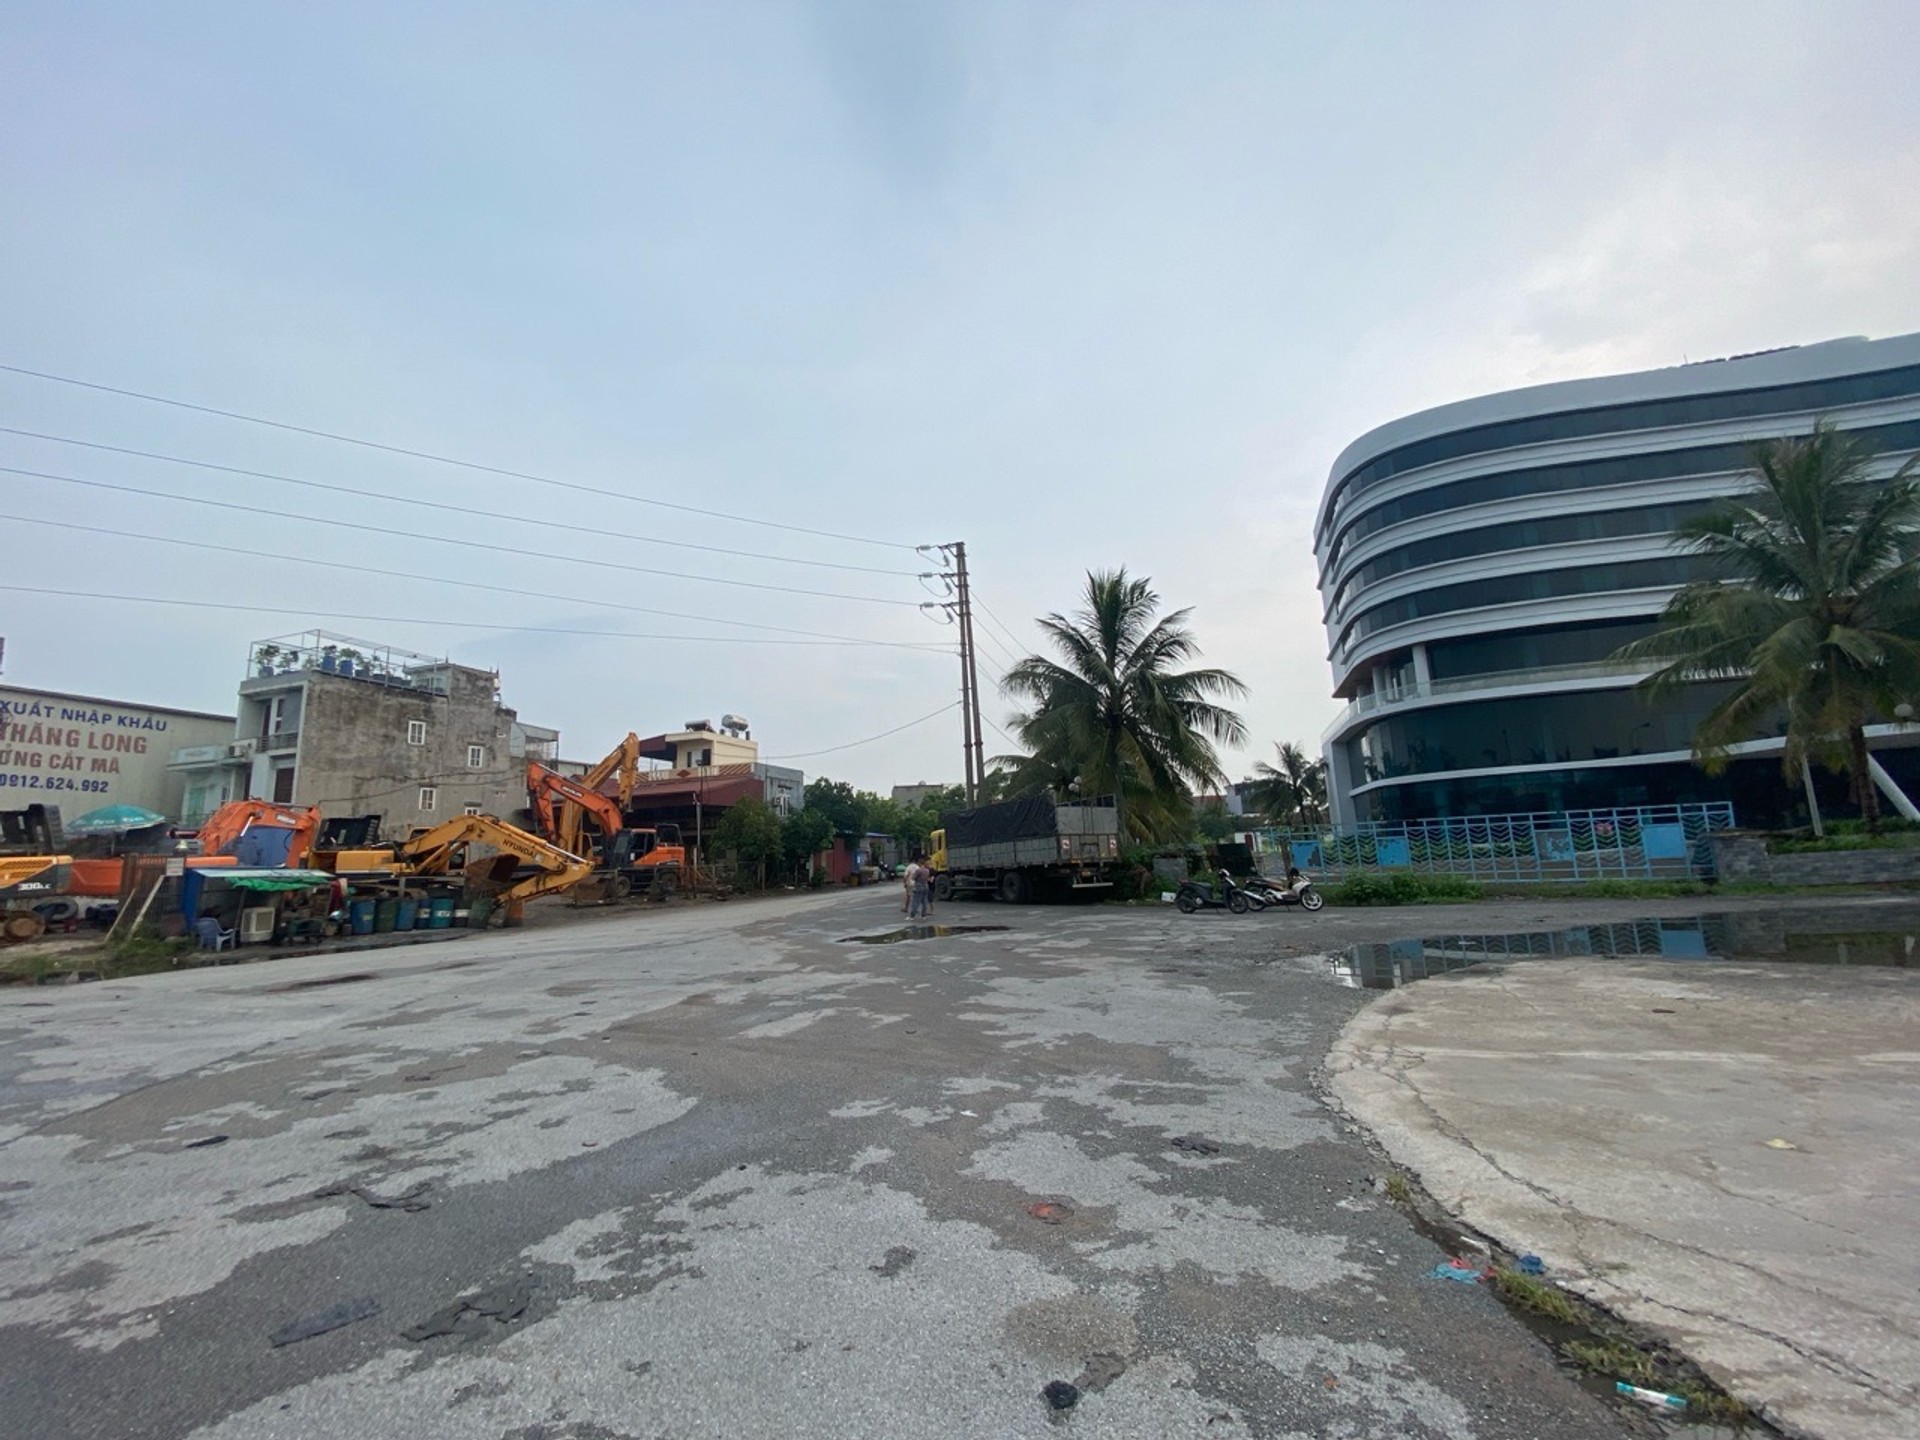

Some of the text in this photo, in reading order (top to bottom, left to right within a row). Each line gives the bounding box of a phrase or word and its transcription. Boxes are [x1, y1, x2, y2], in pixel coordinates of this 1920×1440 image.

[0, 700, 167, 731] XUẤT NHẬP KHẨU
[88, 731, 147, 754] LONG
[49, 750, 84, 771] CẮT
[0, 773, 109, 793] 0912.624.992
